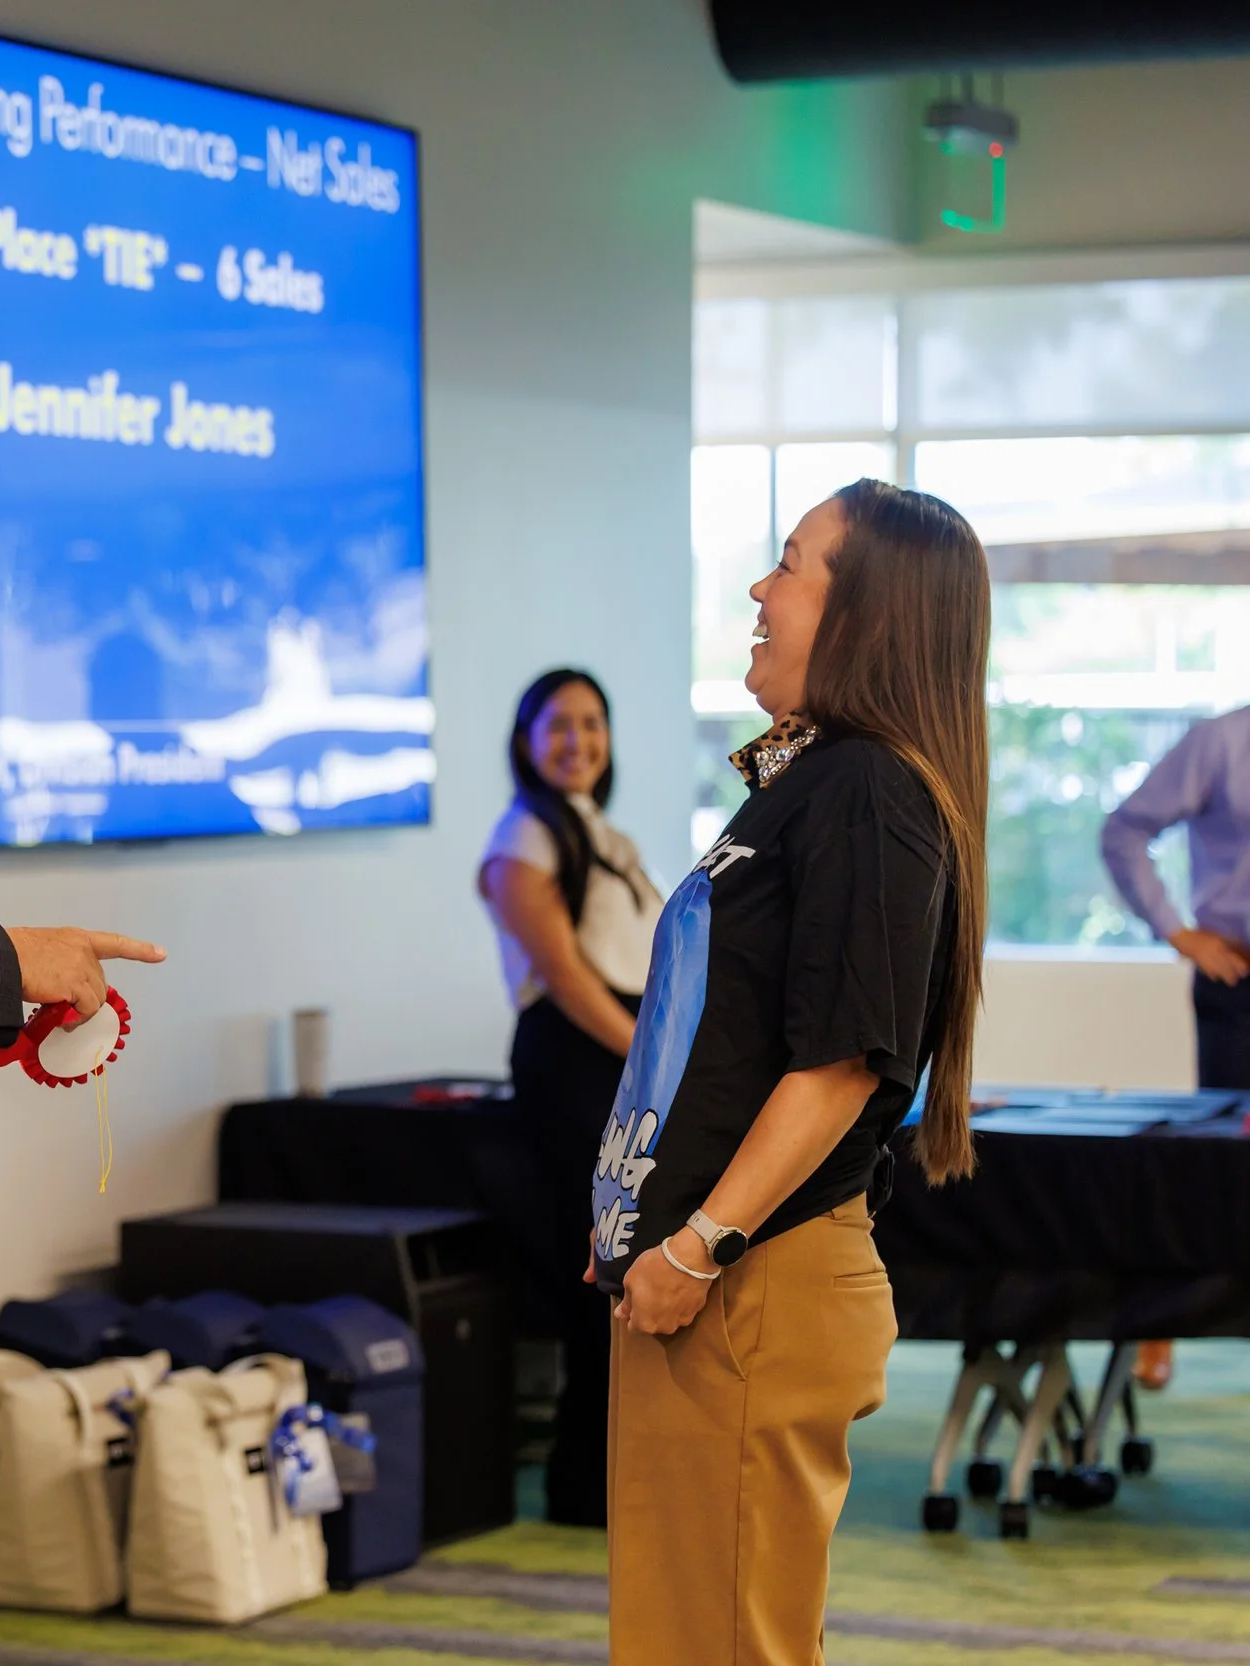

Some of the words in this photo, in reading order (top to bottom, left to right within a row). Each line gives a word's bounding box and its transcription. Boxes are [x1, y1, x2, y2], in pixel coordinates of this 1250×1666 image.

[40, 76, 236, 180] Performance
[267, 130, 323, 196] Net
[326, 138, 399, 213] Sales
[216, 245, 242, 301] 6
[243, 248, 324, 313] Sales
[164, 381, 276, 459] Jones
